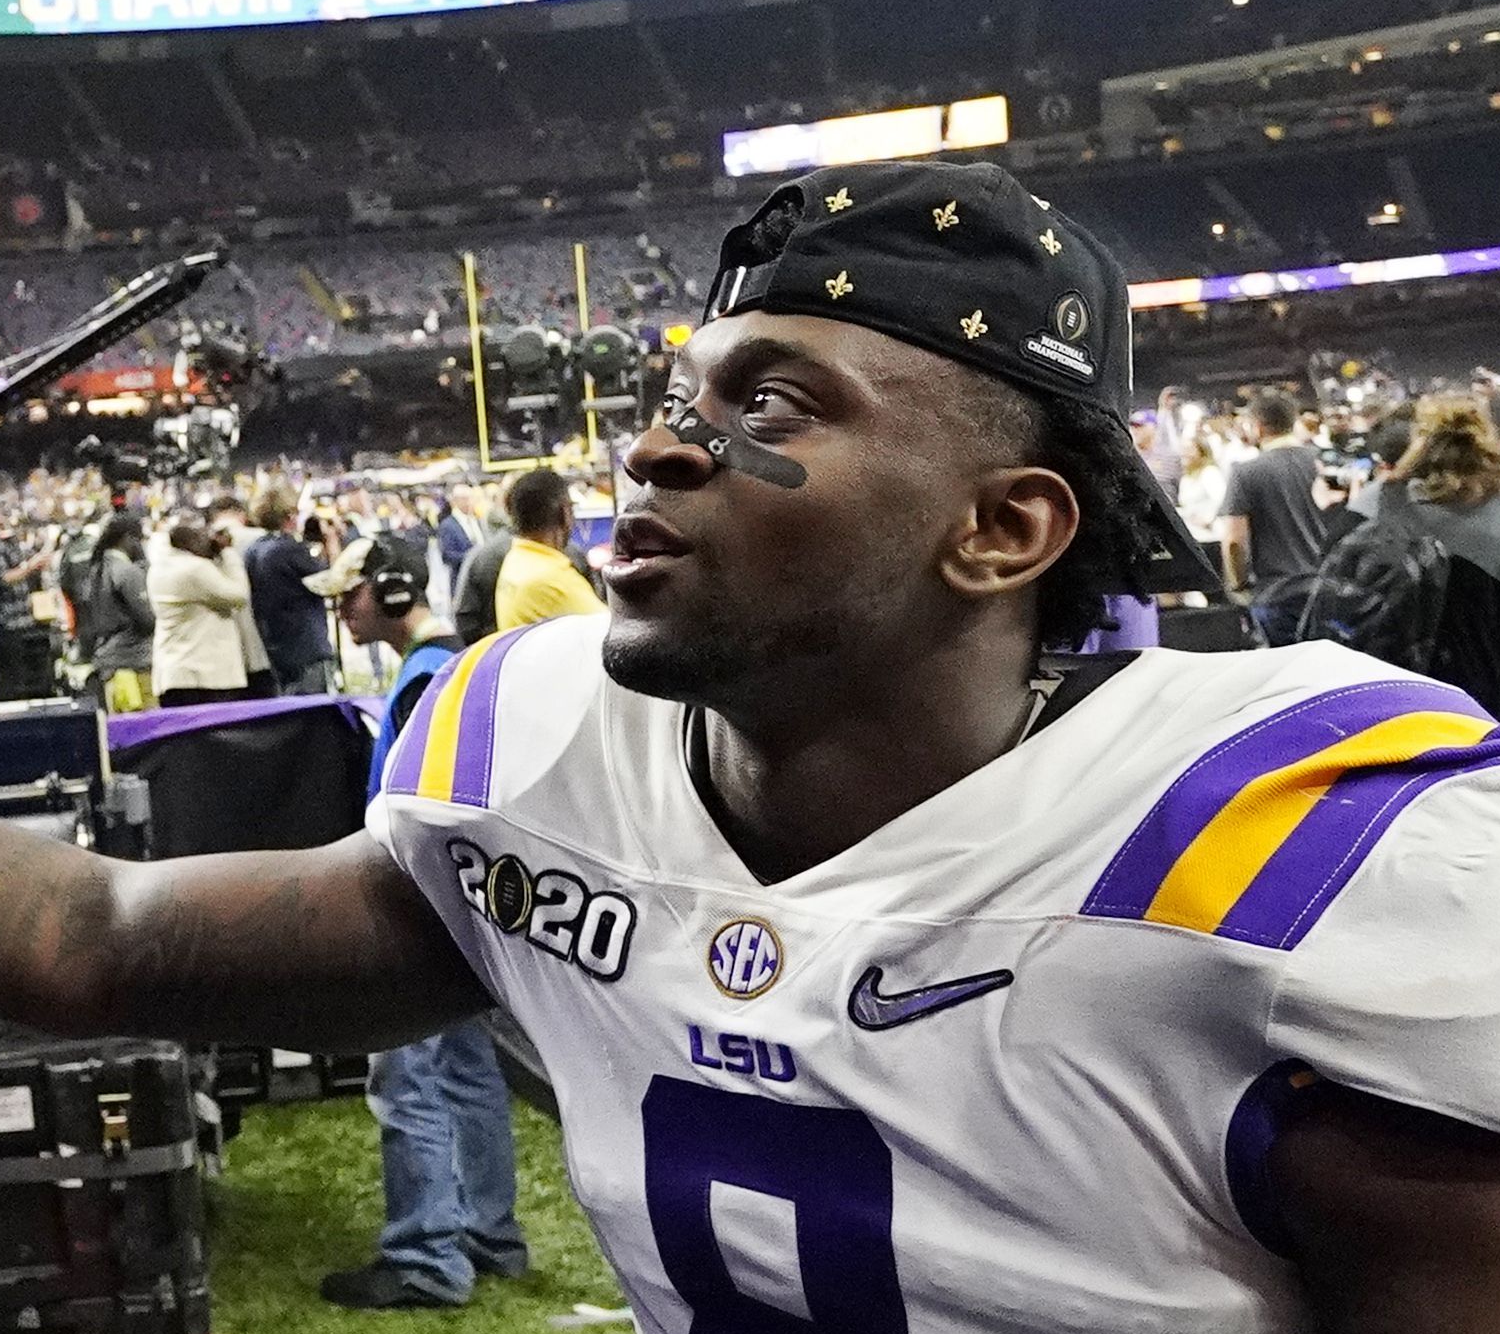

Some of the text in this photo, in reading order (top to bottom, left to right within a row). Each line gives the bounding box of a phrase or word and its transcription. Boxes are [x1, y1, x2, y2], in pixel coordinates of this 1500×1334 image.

[1040, 335, 1085, 363] NATIONAL
[446, 837, 638, 983] 2020
[709, 921, 780, 994] SEC
[688, 1023, 797, 1083] LSU
